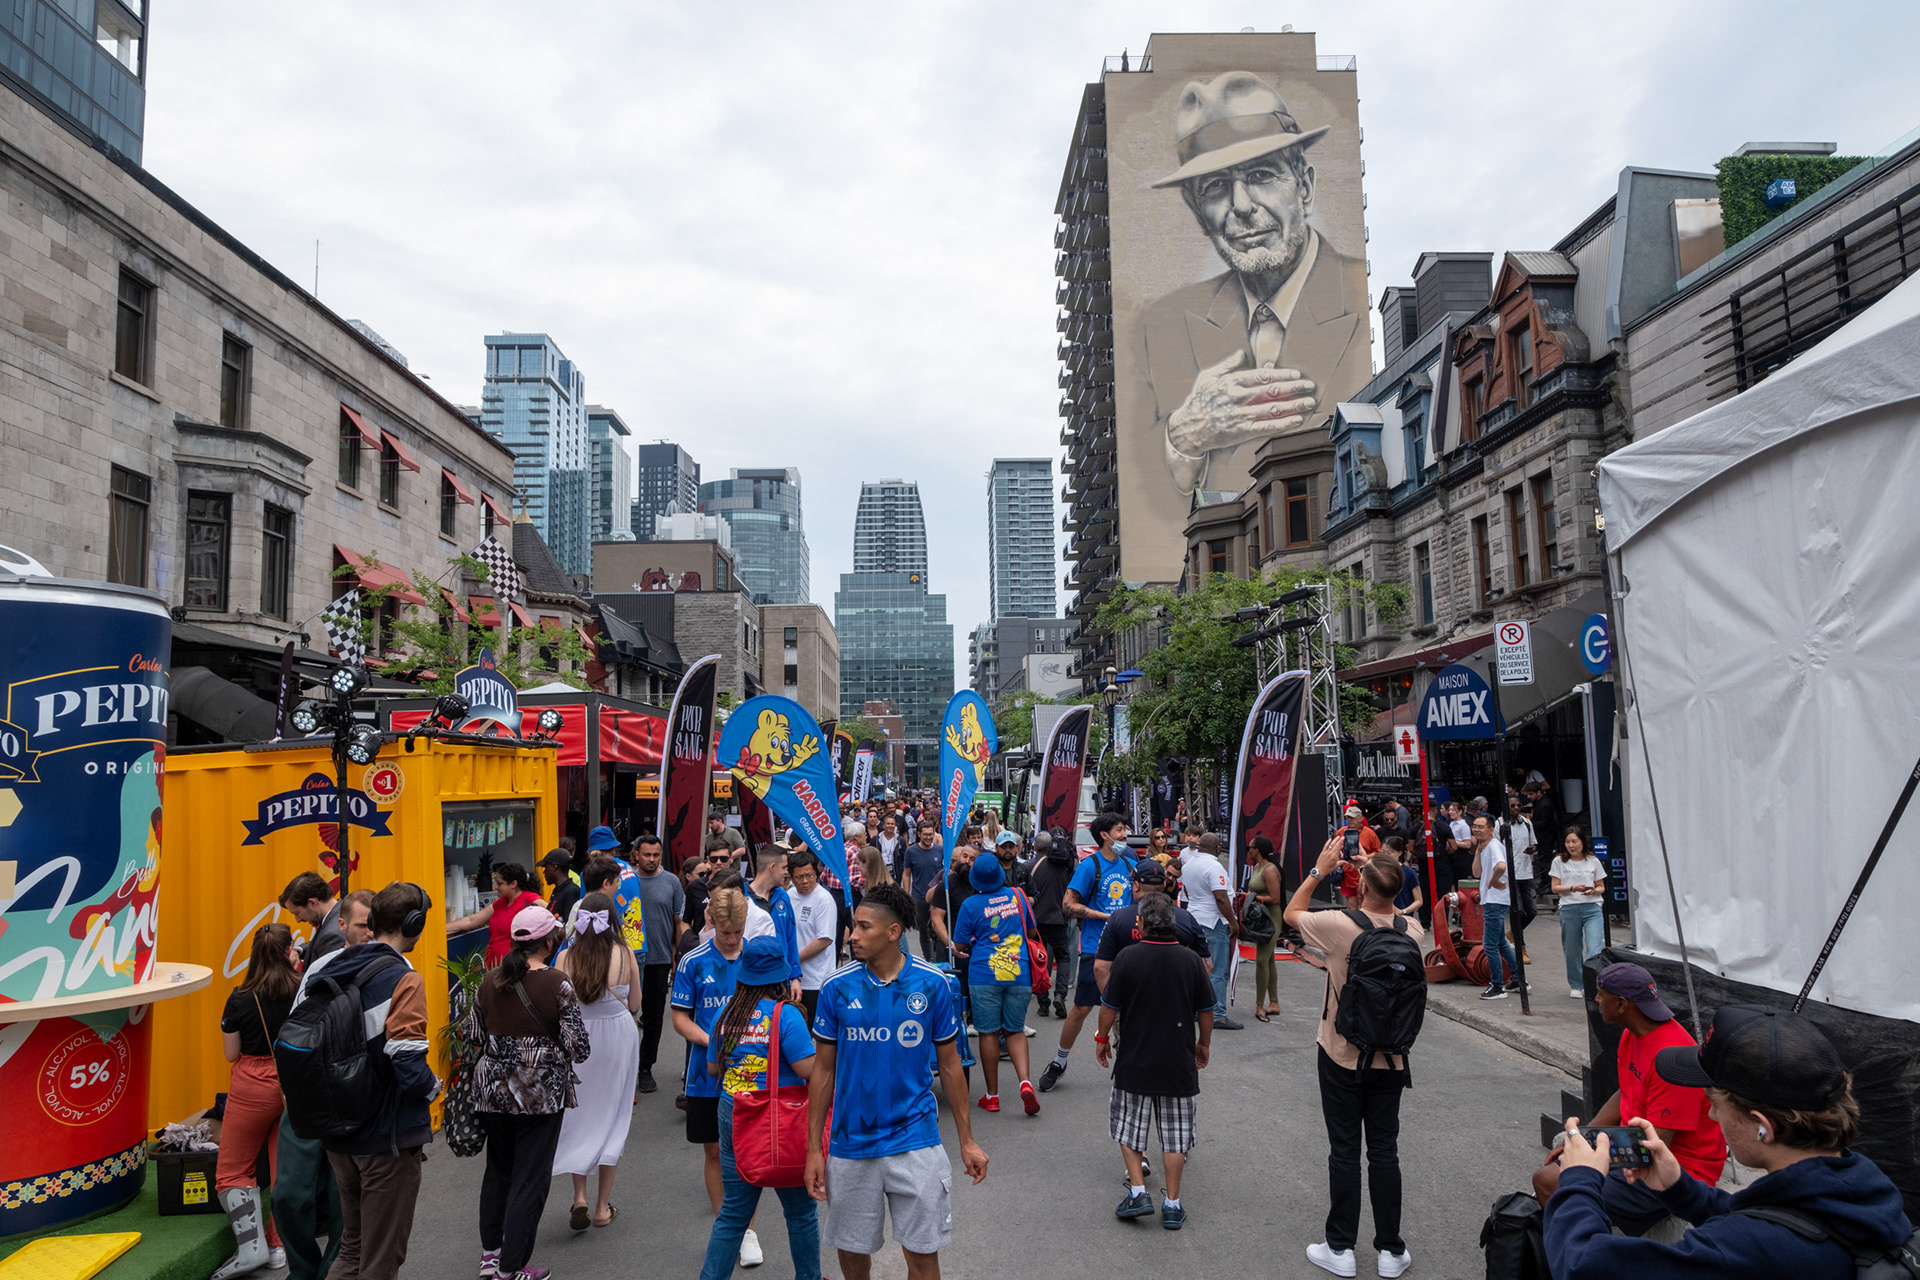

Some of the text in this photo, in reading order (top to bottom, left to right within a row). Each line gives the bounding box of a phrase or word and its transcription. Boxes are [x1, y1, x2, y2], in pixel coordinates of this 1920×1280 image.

[129, 653, 163, 673] Carlos
[1499, 653, 1529, 661] VÉHICULES
[1500, 645, 1526, 653] EXCEPTÉ
[1438, 673, 1469, 690] MAISON
[461, 677, 513, 717] PEPITO
[1426, 690, 1490, 728] AMEX
[680, 704, 703, 733] PUR
[1261, 709, 1288, 736] PUR
[674, 731, 704, 761] SANG
[1058, 733, 1078, 752] PUR
[1255, 733, 1289, 762] SANG
[1053, 750, 1078, 769] SANG
[1356, 751, 1376, 778] JACK
[266, 793, 369, 827] PEPITO
[792, 778, 837, 840] HARIBO
[945, 768, 965, 830] HARIBO
[799, 816, 824, 852] GRATUITS
[1218, 875, 1226, 886] 3
[1611, 858, 1628, 901] CLUB
[846, 1027, 891, 1042] BMO
[70, 1058, 111, 1089] 5%
